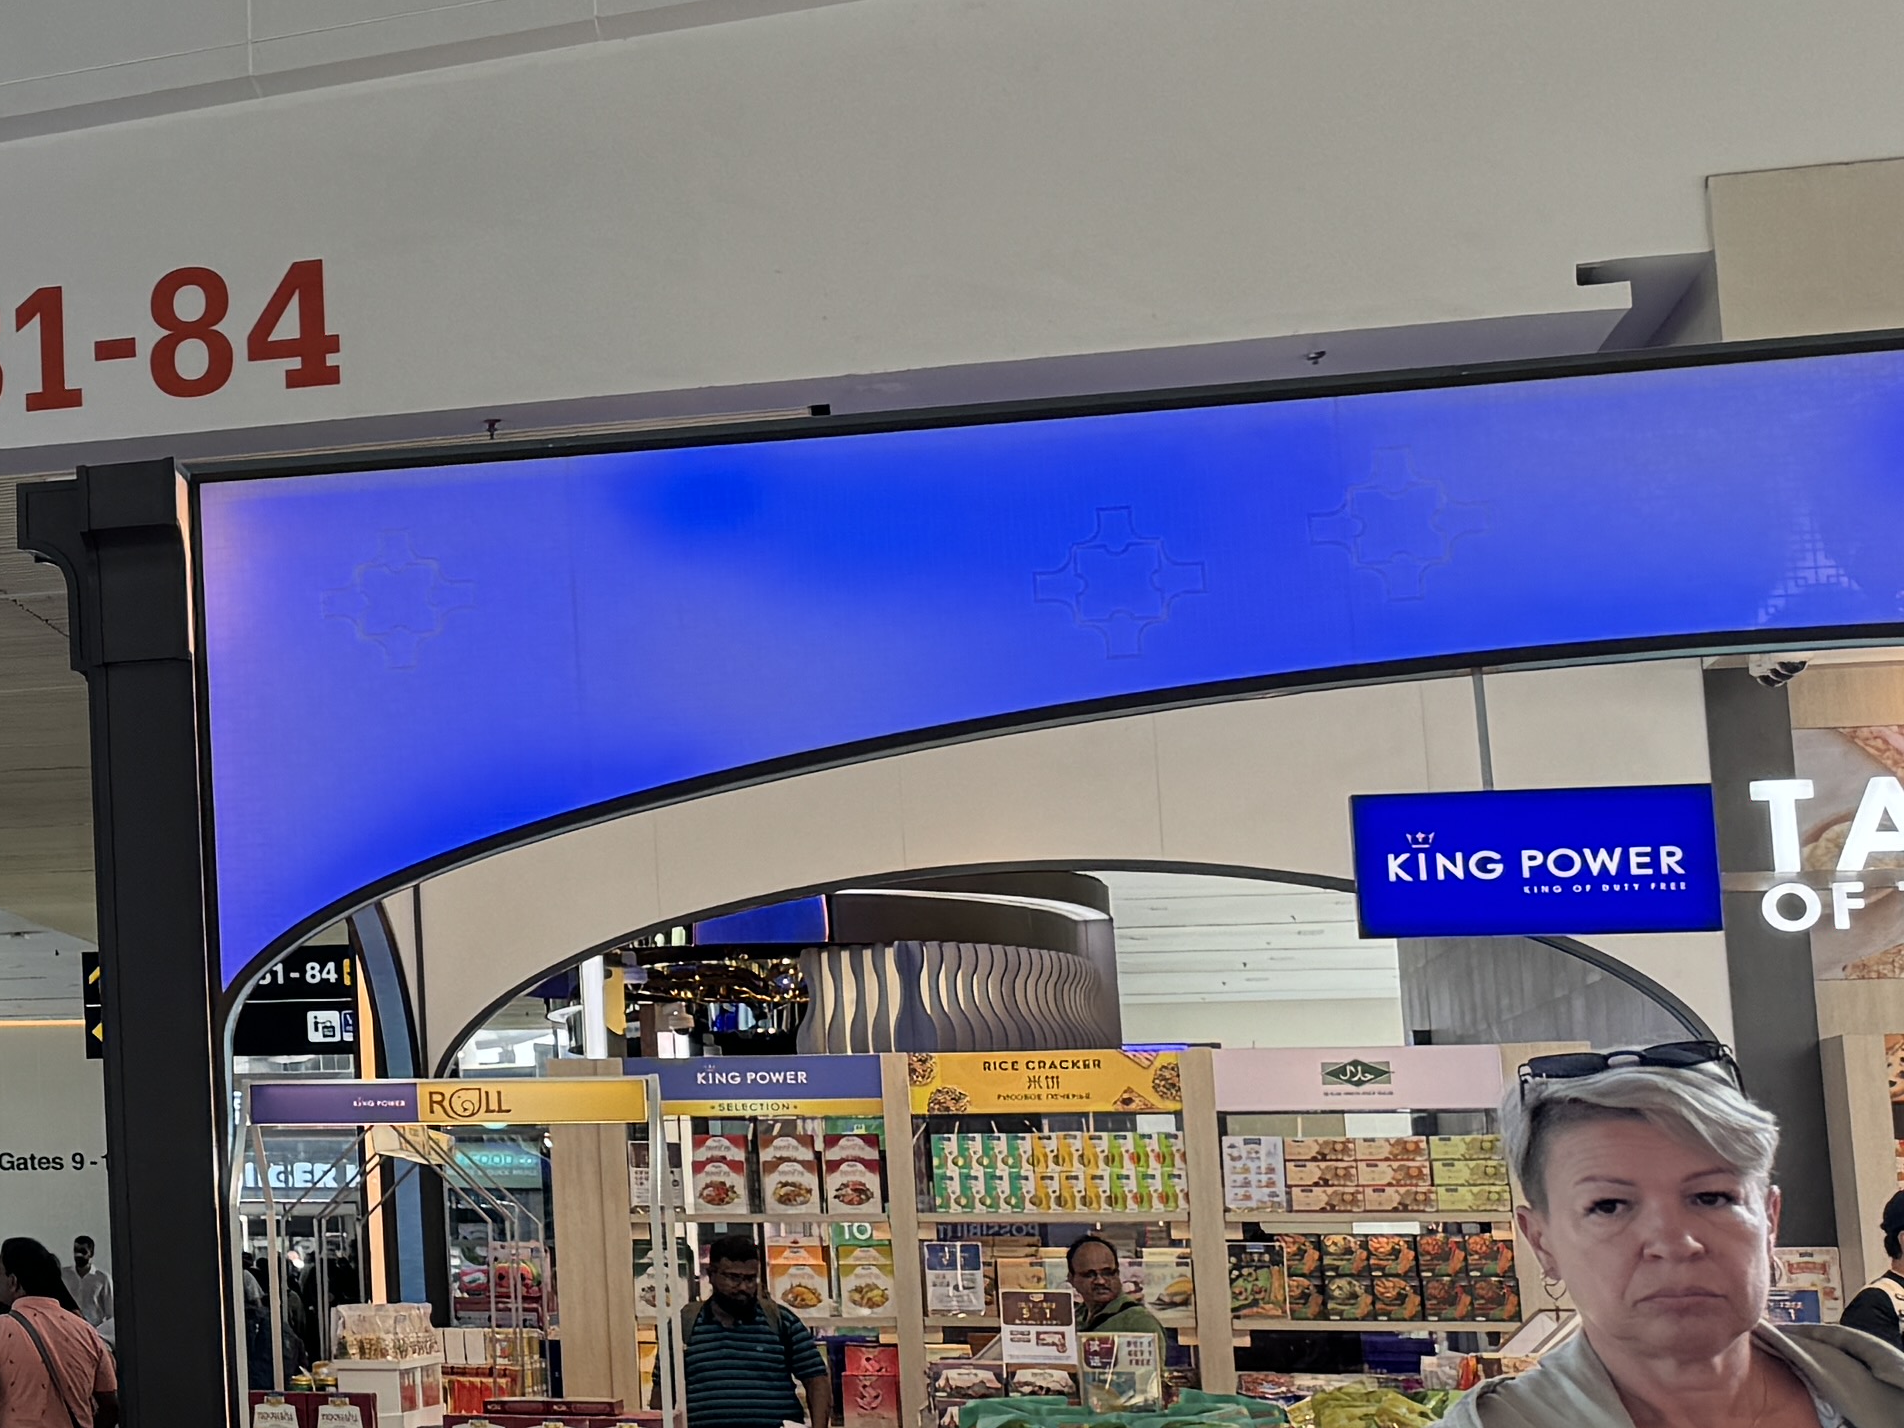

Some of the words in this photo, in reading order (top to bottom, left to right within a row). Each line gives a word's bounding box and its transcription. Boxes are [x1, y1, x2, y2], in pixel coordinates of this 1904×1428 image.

[1387, 850, 1504, 882] KING
[1520, 845, 1686, 878] POWER
[1523, 884, 1562, 894] KING
[1572, 884, 1592, 893] OF
[1602, 882, 1640, 892] DUTY
[1651, 881, 1686, 891] FREE
[1762, 881, 1866, 932] OF
[983, 1060, 1019, 1071] RICE
[1025, 1059, 1101, 1070] CRACKER
[697, 1071, 741, 1084] KING
[746, 1071, 808, 1084] POWER
[718, 1102, 790, 1112] SELECTION
